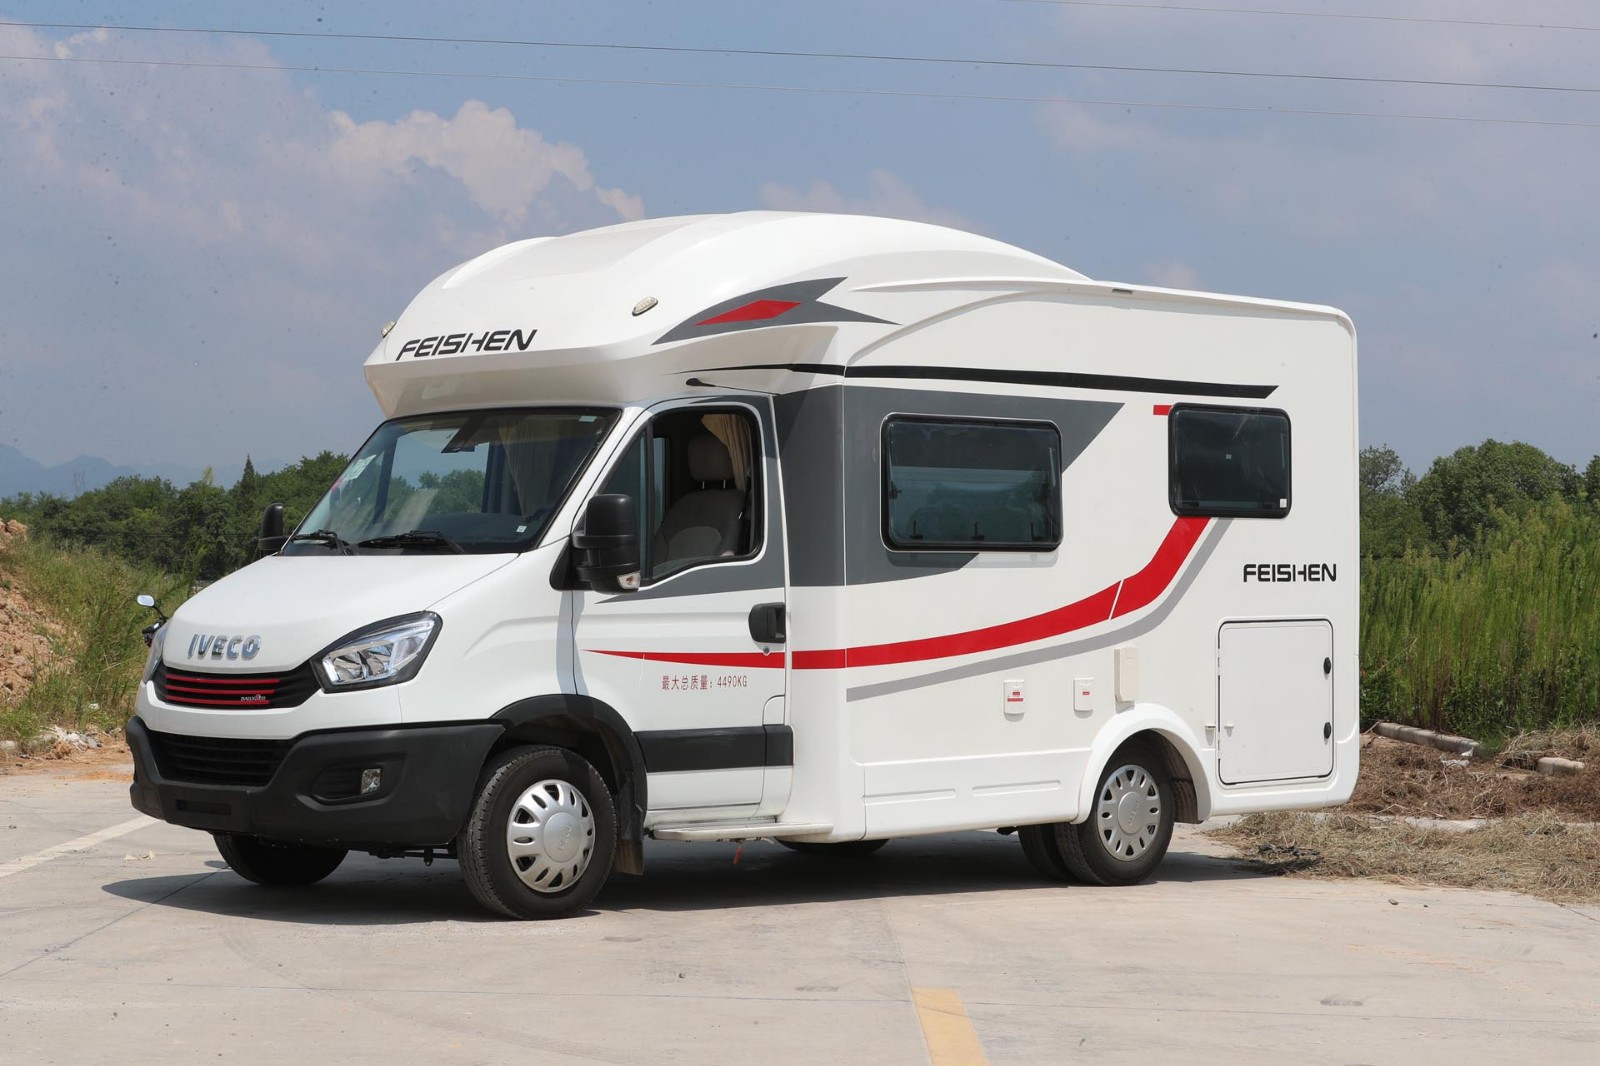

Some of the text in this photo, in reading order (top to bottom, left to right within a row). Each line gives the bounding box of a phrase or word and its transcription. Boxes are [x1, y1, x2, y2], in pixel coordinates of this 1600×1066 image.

[395, 329, 538, 361] FEISHEN
[1243, 563, 1337, 582] FEISHEN
[187, 634, 261, 659] IVECO
